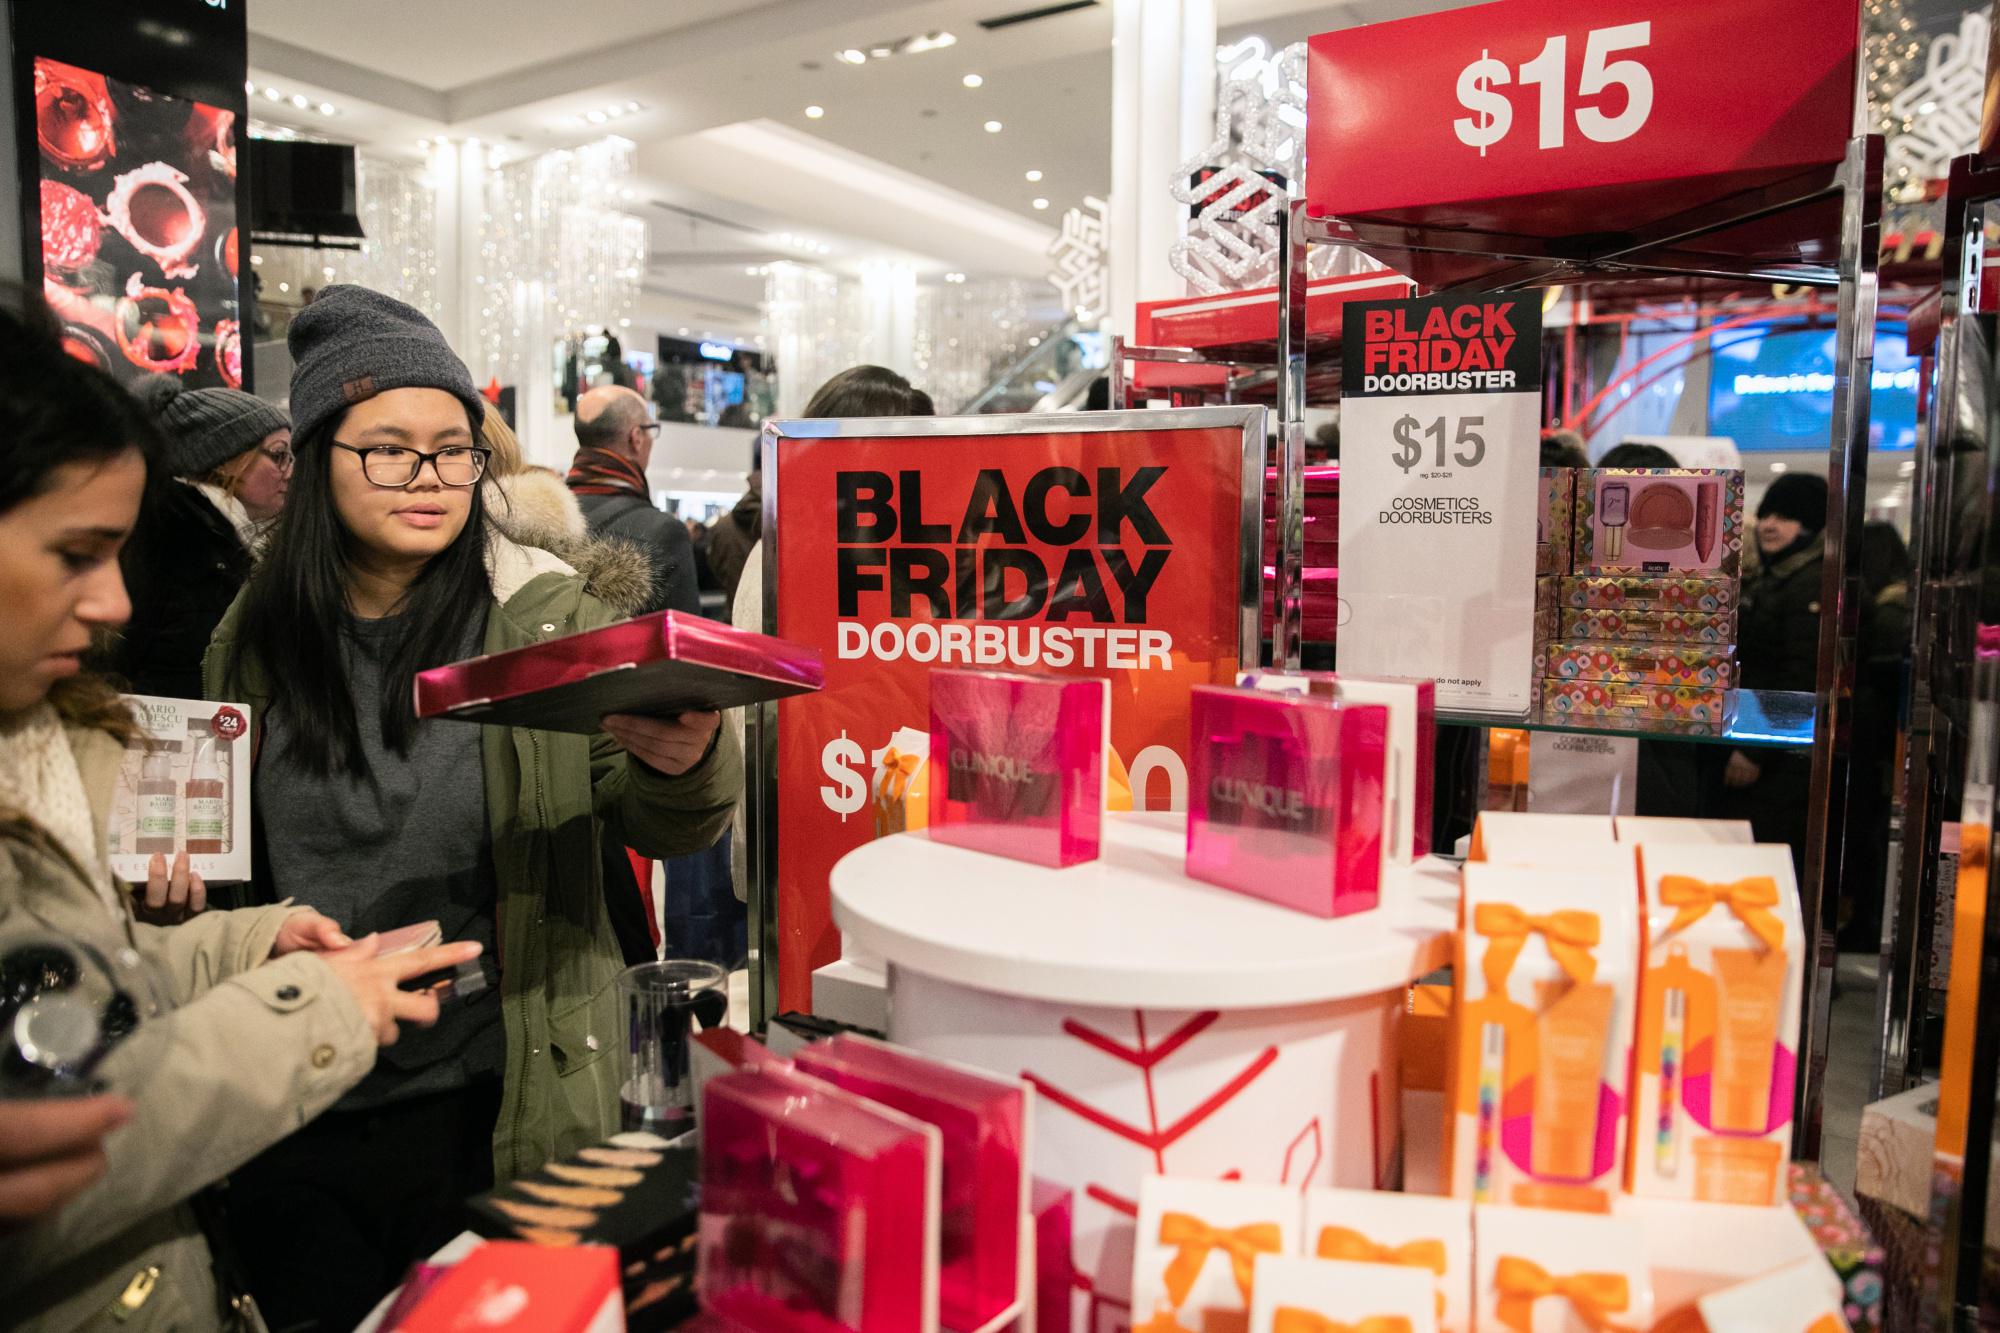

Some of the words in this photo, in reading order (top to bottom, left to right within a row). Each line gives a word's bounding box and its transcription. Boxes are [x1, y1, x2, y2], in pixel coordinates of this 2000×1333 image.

[1453, 20, 1653, 157] $15
[1365, 302, 1517, 343] BLACK
[1364, 336, 1517, 375] FRIDAY
[1364, 370, 1517, 393] DOORBUSTER
[1391, 413, 1486, 474] $15
[836, 466, 1174, 546] BLACK
[1379, 511, 1493, 524] DOORBUSTERS
[1392, 497, 1479, 511] COSMETICS
[837, 547, 1173, 624] FRIDAY
[837, 621, 1173, 671] DOORBUSTER
[1461, 679, 1482, 687] apply
[219, 715, 238, 728] $24
[951, 749, 1033, 783] CLINIQUE
[1211, 776, 1304, 820] CLINIQUE
